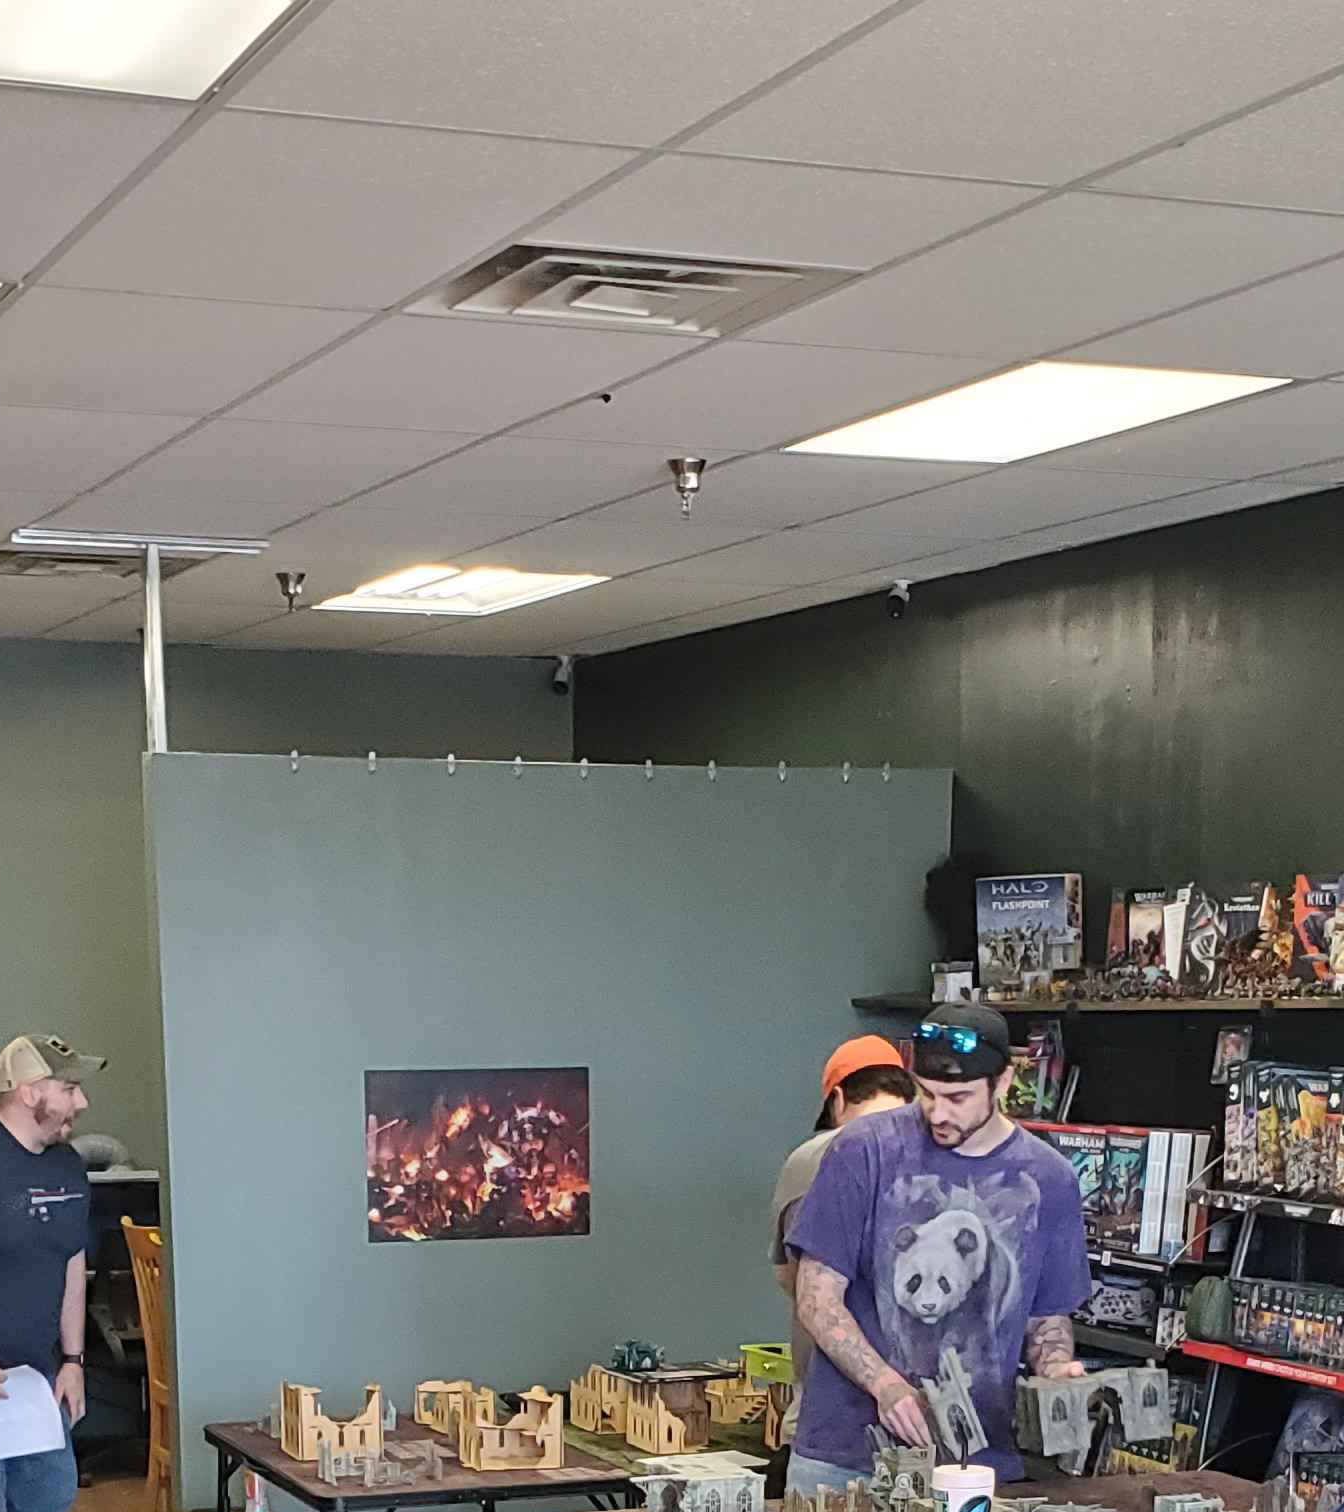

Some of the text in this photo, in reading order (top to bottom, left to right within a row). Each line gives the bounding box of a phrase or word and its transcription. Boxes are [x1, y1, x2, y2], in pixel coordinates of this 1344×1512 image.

[992, 881, 1049, 894] HALO
[992, 900, 1050, 911] FLASHPOINT
[1307, 893, 1334, 906] KILL
